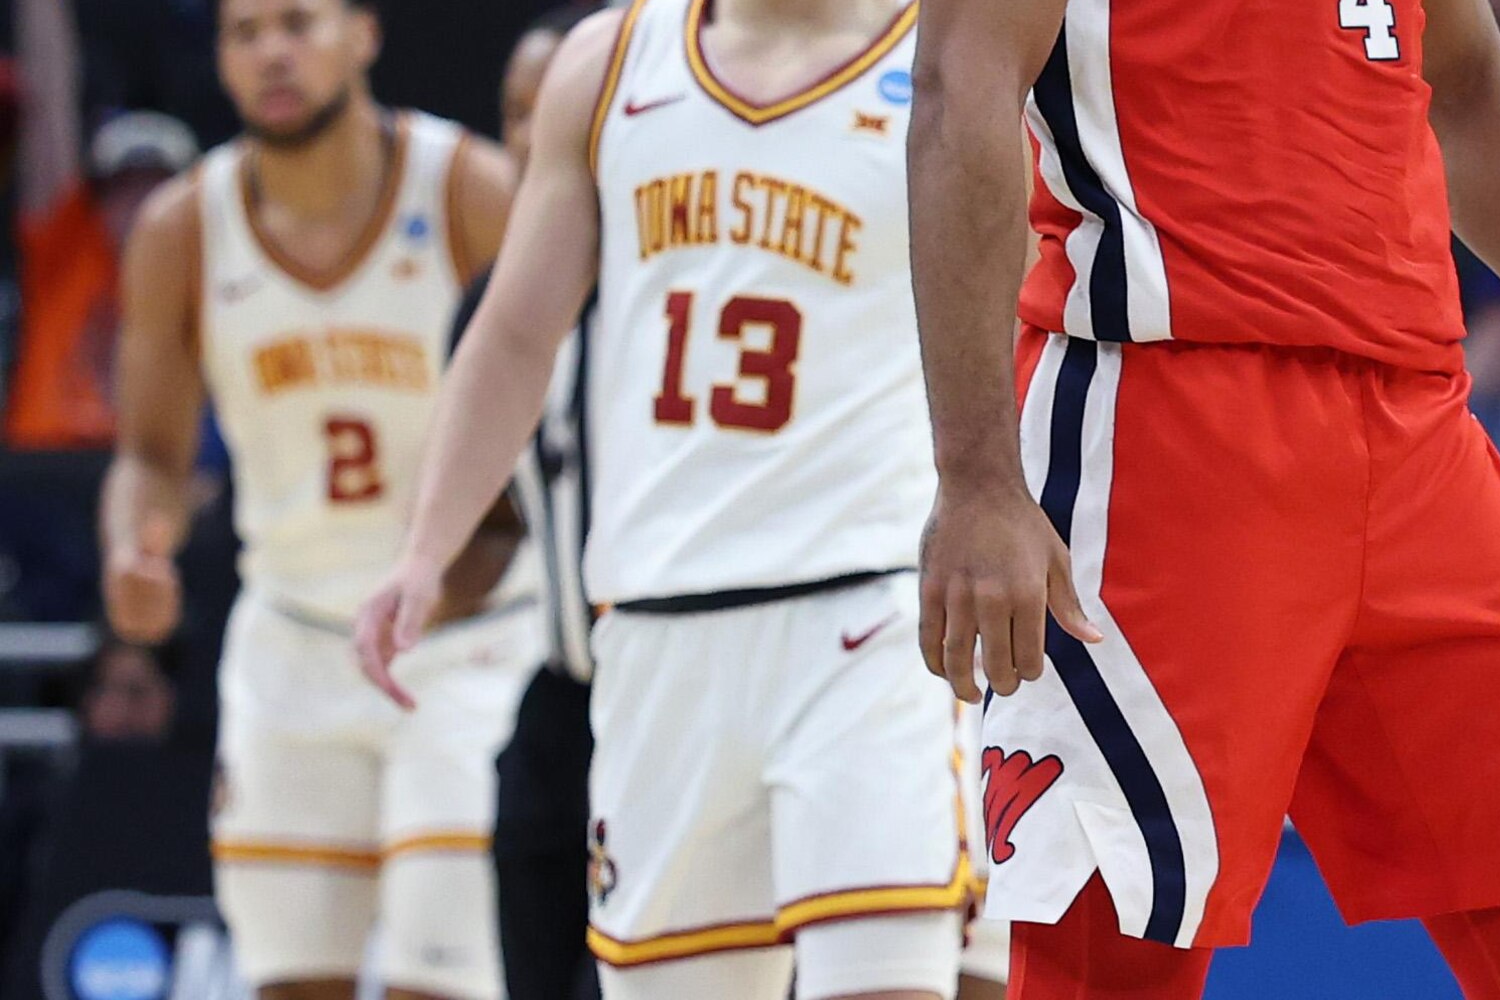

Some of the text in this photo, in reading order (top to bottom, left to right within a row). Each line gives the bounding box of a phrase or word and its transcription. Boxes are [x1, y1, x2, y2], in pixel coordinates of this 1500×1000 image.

[634, 169, 864, 287] IOWA STATE
[652, 290, 804, 433] 13
[324, 413, 384, 506] 2
